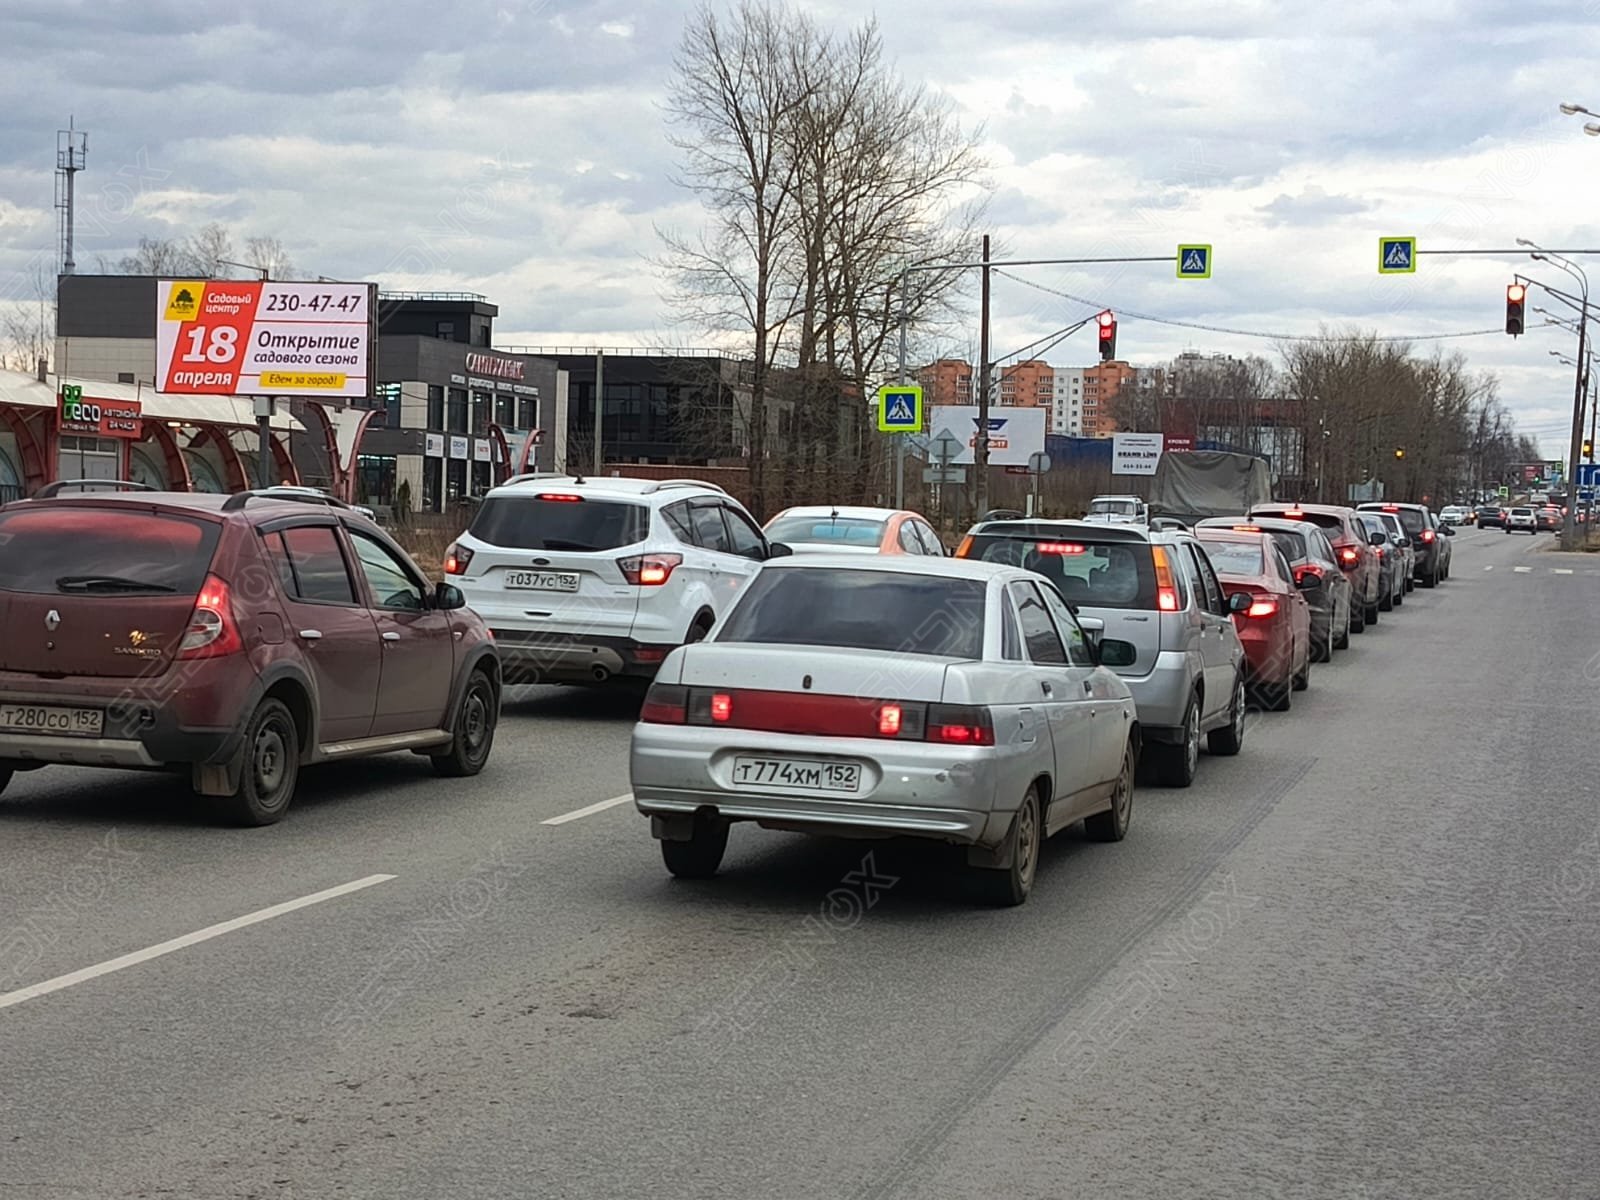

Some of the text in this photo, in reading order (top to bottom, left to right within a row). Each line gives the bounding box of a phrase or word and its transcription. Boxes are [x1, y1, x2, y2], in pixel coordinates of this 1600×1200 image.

[207, 292, 252, 305] Садовый
[266, 294, 362, 313] 230-47-47
[205, 304, 240, 316] центр
[182, 325, 239, 364] 18
[257, 330, 360, 352] Открытие
[254, 350, 359, 365] садового сезона
[173, 371, 233, 389] апреля
[269, 374, 338, 387] Едем за город!
[559, 574, 576, 585] 152
[73, 710, 99, 726] 152
[824, 764, 855, 782] 152
